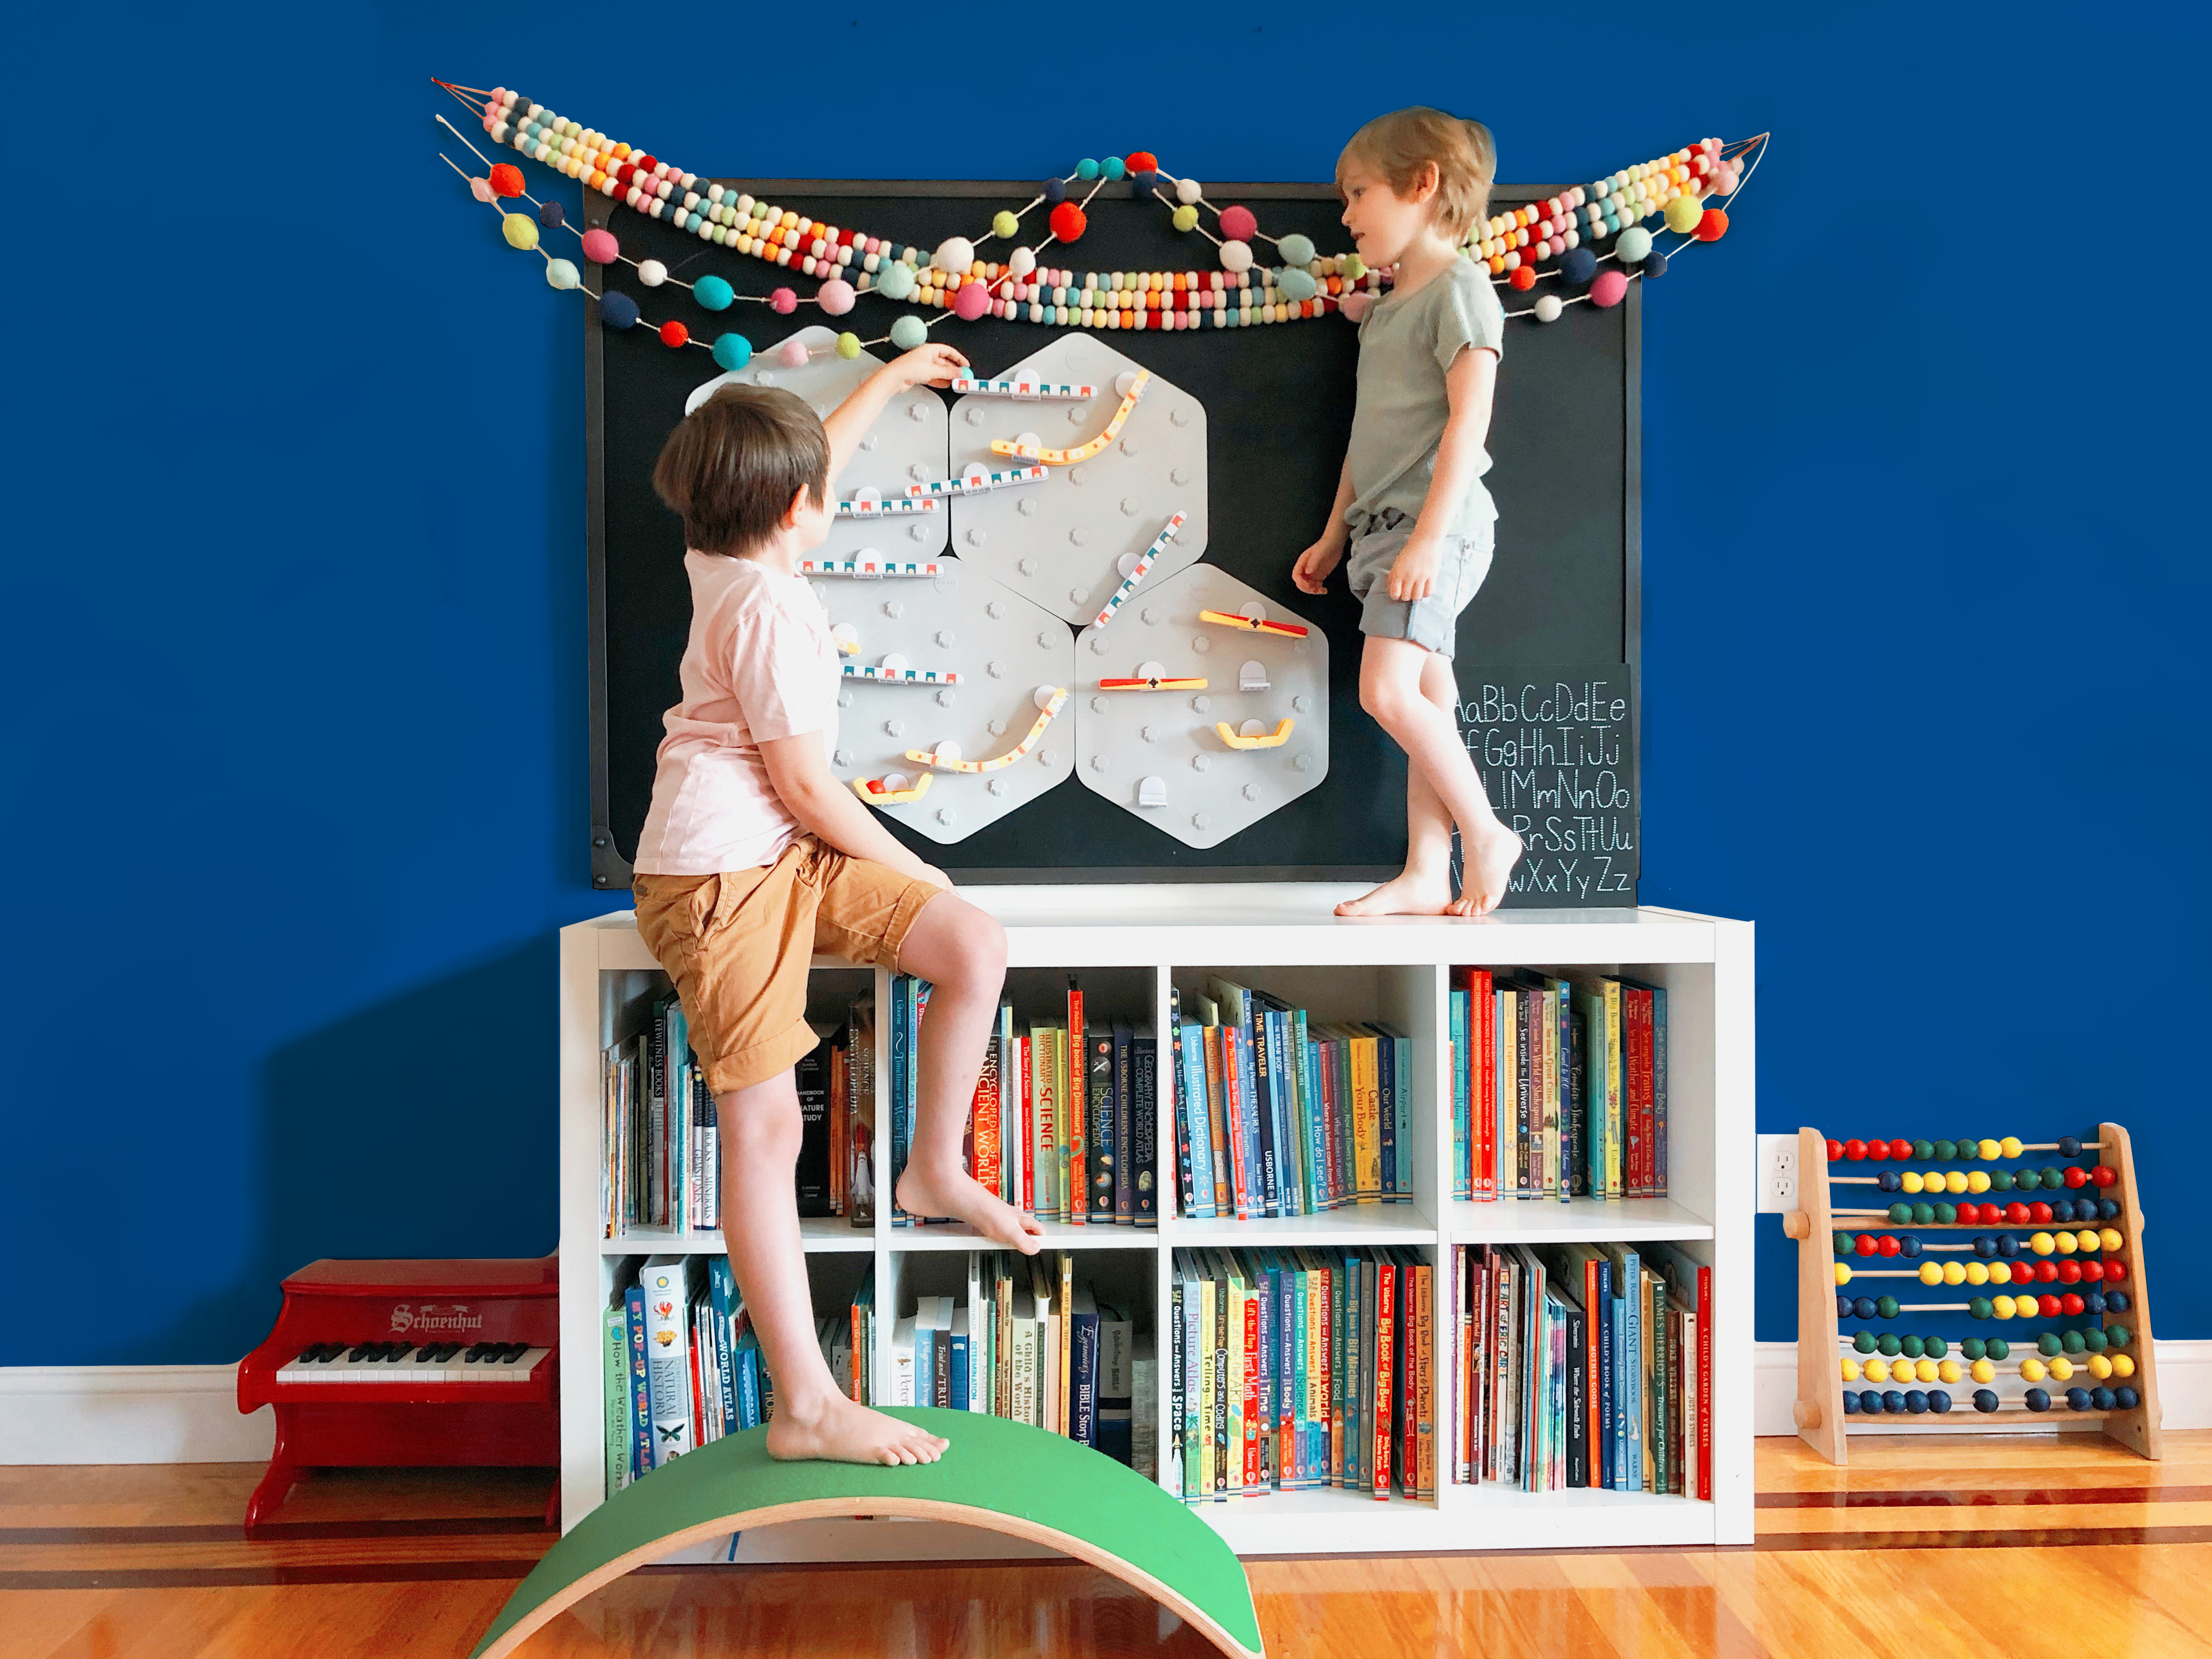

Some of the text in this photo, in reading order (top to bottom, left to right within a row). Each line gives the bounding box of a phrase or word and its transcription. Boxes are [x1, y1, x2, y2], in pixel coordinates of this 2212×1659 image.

[896, 1000, 904, 1025] Usborne
[1255, 1013, 1266, 1077] TIME TRAVELER
[1519, 1028, 1528, 1041] See
[1643, 1030, 1652, 1044] See
[859, 1047, 869, 1096] SCIENCE
[1520, 1044, 1528, 1065] inside
[849, 1029, 858, 1115] ENCYCLOPEDIA
[1073, 1077, 1082, 1090] Big
[1643, 1069, 1653, 1100] Trains
[1073, 1092, 1083, 1133] Dinosaurs
[1190, 1036, 1207, 1171] Usborne Illustrated Dictionary
[1250, 1090, 1259, 1134] THESAURUS
[1356, 1087, 1366, 1140] Your Body
[1368, 1090, 1378, 1120] Castle
[1382, 1088, 1392, 1130] Our World
[1519, 1078, 1529, 1118] Universe
[895, 1103, 904, 1131] World
[1040, 1087, 1054, 1152] SCIENCE
[1100, 1087, 1113, 1147] SCIENCE
[1144, 1101, 1154, 1163] ENCYCLOPEDIA
[895, 1132, 905, 1163] History
[989, 1145, 997, 1159] OF
[1314, 1126, 1323, 1145] How
[1315, 1147, 1323, 1157] do
[978, 1131, 989, 1185] WORLD
[989, 1165, 997, 1185] THE
[1265, 1151, 1274, 1190] USBORNE
[1316, 1164, 1325, 1186] see?
[704, 1176, 713, 1219] MINERALS
[1500, 1269, 1509, 1289] THE
[388, 1304, 483, 1333] Schoenhut
[1499, 1294, 1508, 1311] ART
[1380, 1318, 1391, 1333] Big
[1627, 1315, 1638, 1355] GIANT
[613, 1342, 622, 1368] How
[1188, 1313, 1198, 1392] Picture Atlas
[1244, 1352, 1256, 1374] First
[1381, 1336, 1390, 1361] Book
[720, 1343, 734, 1420] WORLD ATLAS
[1203, 1355, 1212, 1392] Telling
[1216, 1348, 1227, 1388] Computers
[1379, 1372, 1390, 1387] Big
[637, 1382, 648, 1427] WORLD
[653, 1360, 665, 1417] HISTORY
[664, 1360, 676, 1417] NATURAL
[1014, 1382, 1023, 1416] World
[1079, 1384, 1089, 1412] BIBLE
[1244, 1376, 1256, 1400] Math
[1379, 1388, 1389, 1412] Bugs
[616, 1397, 625, 1449] Weather
[1077, 1414, 1090, 1437] Story
[1172, 1396, 1183, 1431] Space
[1216, 1404, 1226, 1429] Coding
[639, 1431, 651, 1473] ATLAS
[616, 1453, 624, 1488] Works
